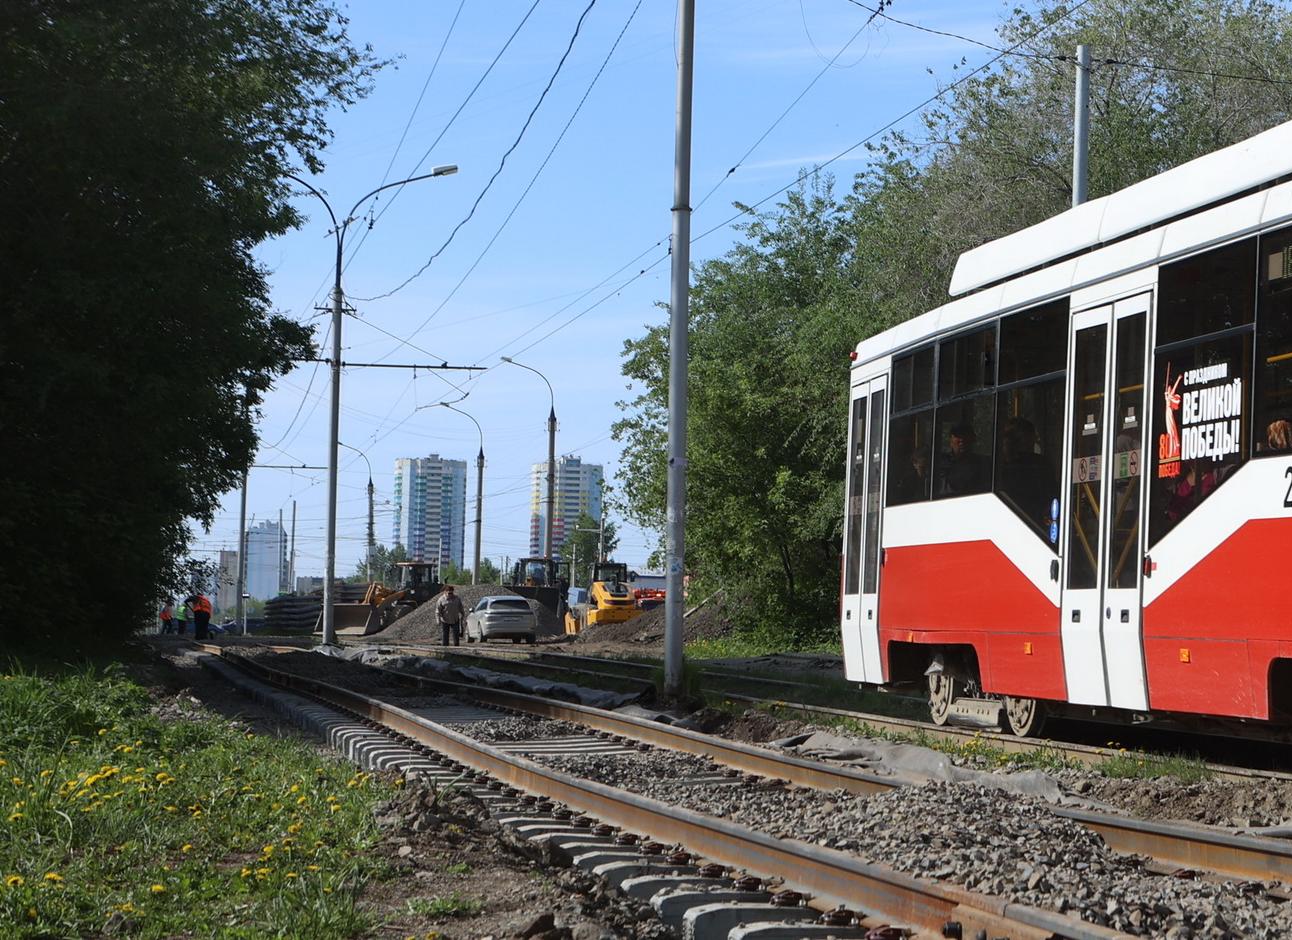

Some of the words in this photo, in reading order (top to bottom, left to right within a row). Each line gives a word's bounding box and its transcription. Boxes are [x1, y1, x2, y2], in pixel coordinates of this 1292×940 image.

[1184, 371, 1189, 386] С
[1182, 377, 1242, 425] ВЕЛИКОЙ
[1181, 419, 1240, 462] ПОБЕДЫ!
